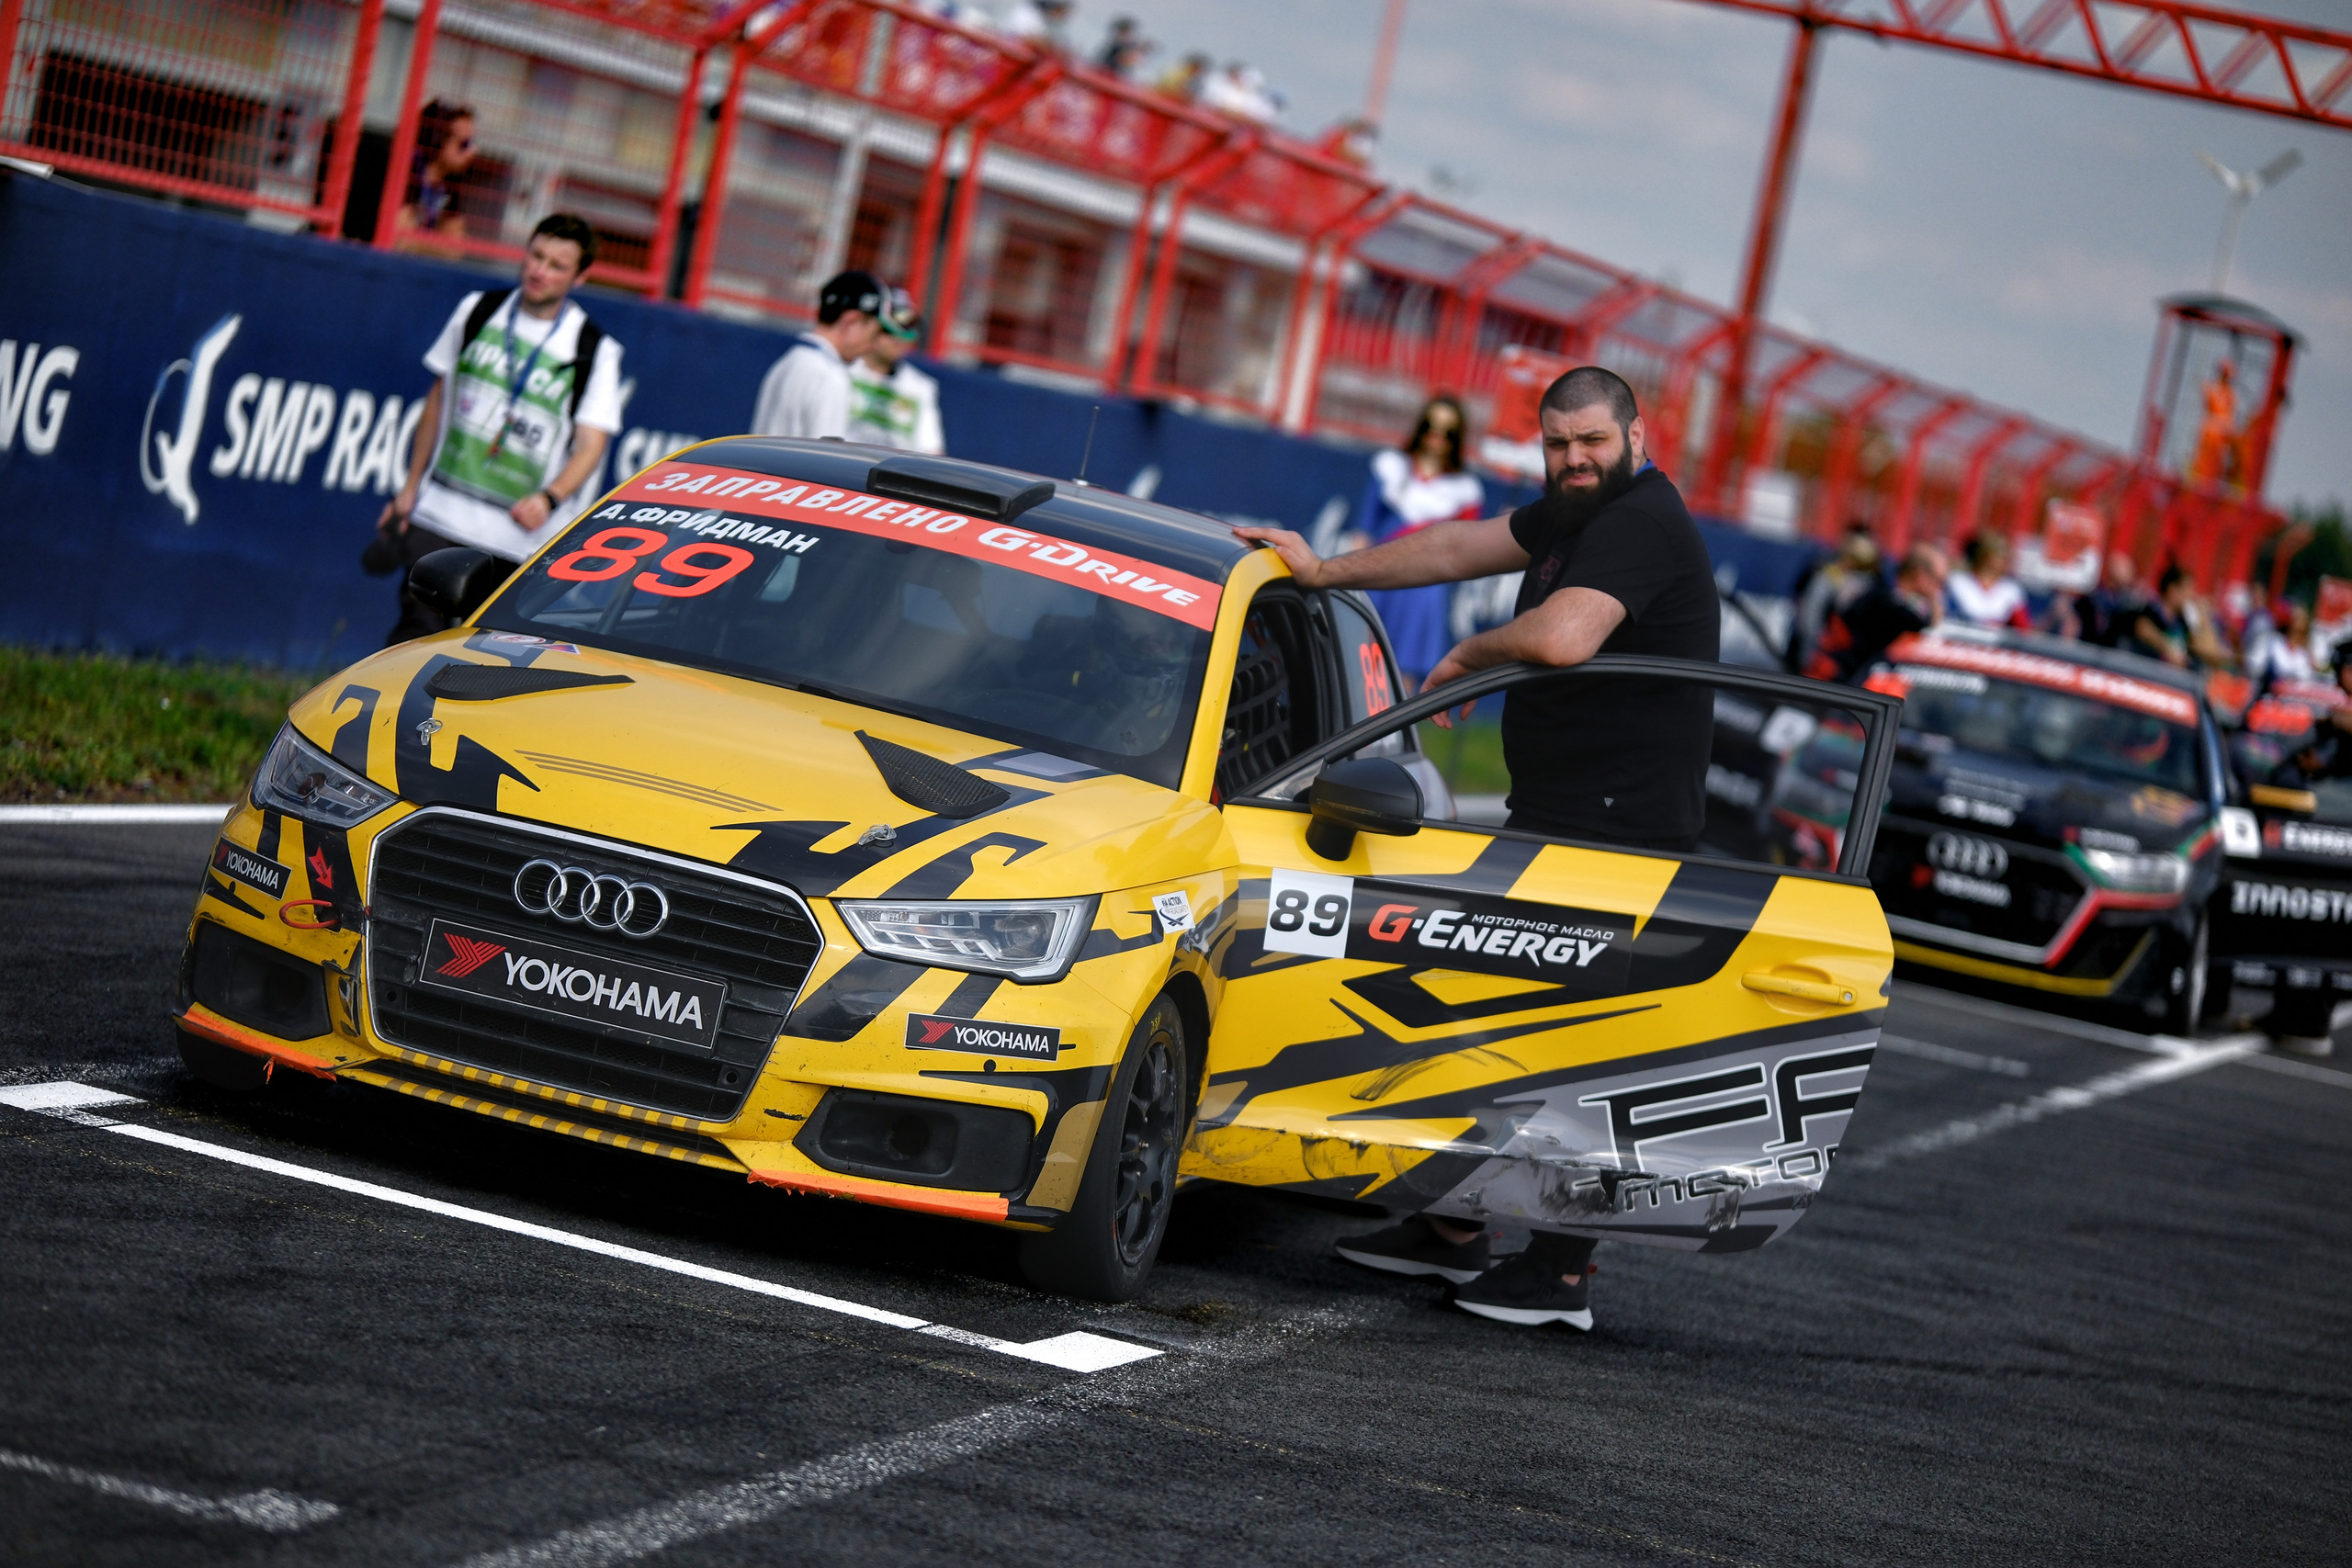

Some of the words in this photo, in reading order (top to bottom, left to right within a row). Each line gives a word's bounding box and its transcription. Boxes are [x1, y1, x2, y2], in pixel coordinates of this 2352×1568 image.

[209, 372, 337, 485] SMP
[322, 387, 428, 496] RAC
[644, 471, 969, 534] ЗАПРАВЛЕНО
[547, 525, 755, 597] 89
[1359, 642, 1391, 717] 89
[226, 850, 280, 890] YOKOHAMA
[1269, 888, 1350, 937] 89
[1367, 903, 1609, 968] G-ENERGY
[1471, 913, 1560, 935] МОТОРНОЕ
[1560, 924, 1615, 941] МАСЛО
[504, 953, 704, 1031] YOKOHAMA
[954, 1024, 1050, 1054] YOKOHAMA
